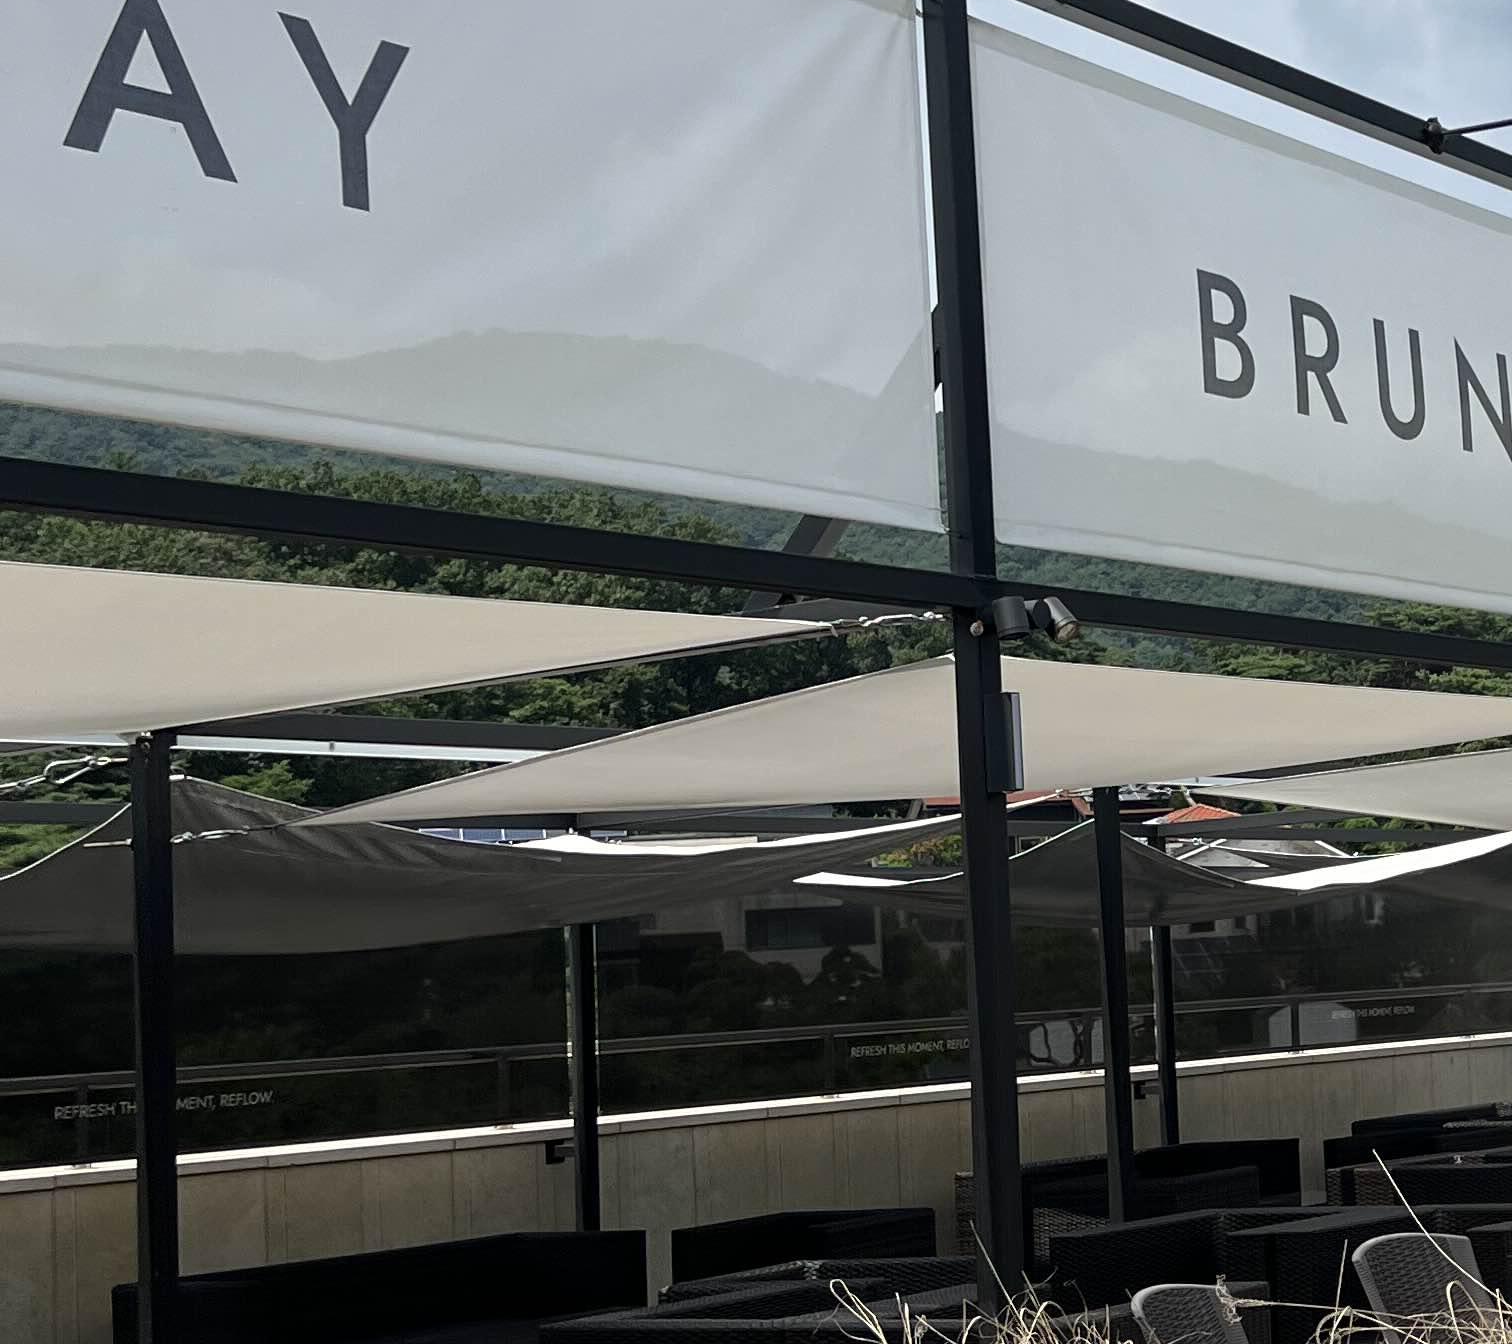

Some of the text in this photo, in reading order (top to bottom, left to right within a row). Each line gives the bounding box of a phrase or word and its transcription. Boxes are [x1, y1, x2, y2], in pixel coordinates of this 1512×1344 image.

[850, 1044, 887, 1057] REFRESH
[888, 1042, 906, 1055] THIS
[947, 1038, 969, 1050] REFLO
[54, 1103, 116, 1120] REFRESH
